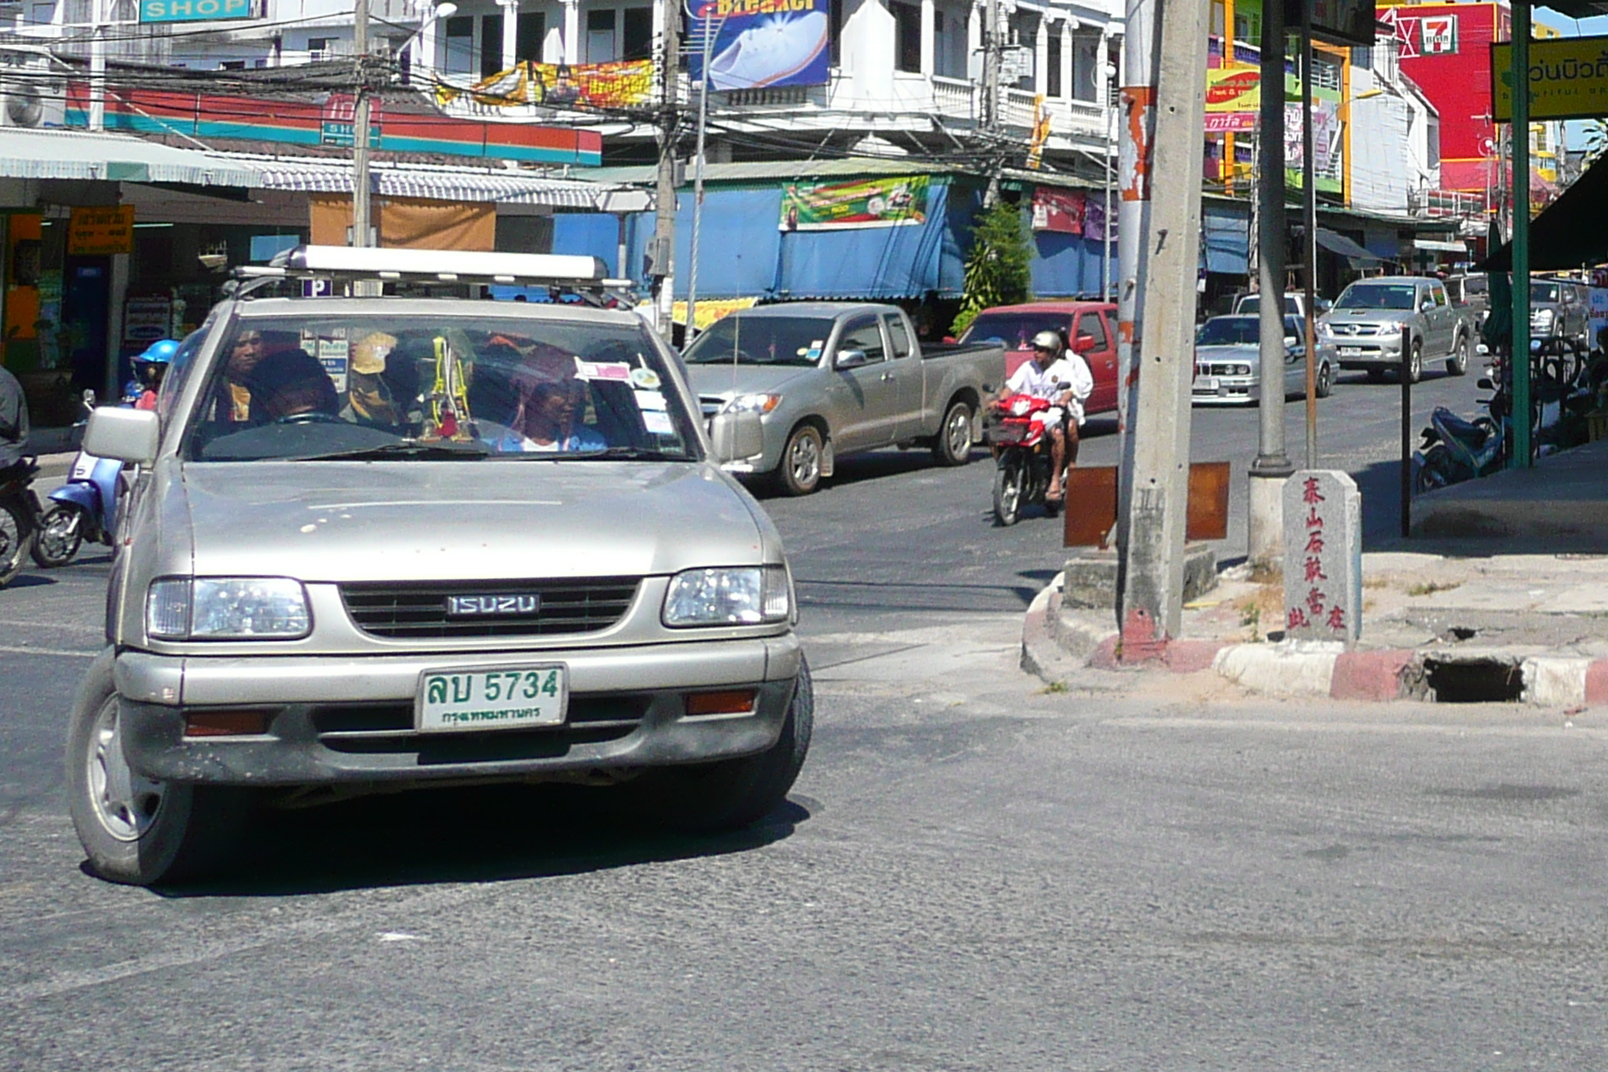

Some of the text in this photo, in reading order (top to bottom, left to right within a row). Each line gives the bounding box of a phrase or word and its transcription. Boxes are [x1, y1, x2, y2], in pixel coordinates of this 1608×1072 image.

[1427, 21, 1448, 51] 7
[331, 101, 374, 120] 10
[450, 595, 538, 614] ISUZU
[427, 670, 558, 704] ลบ 5734
